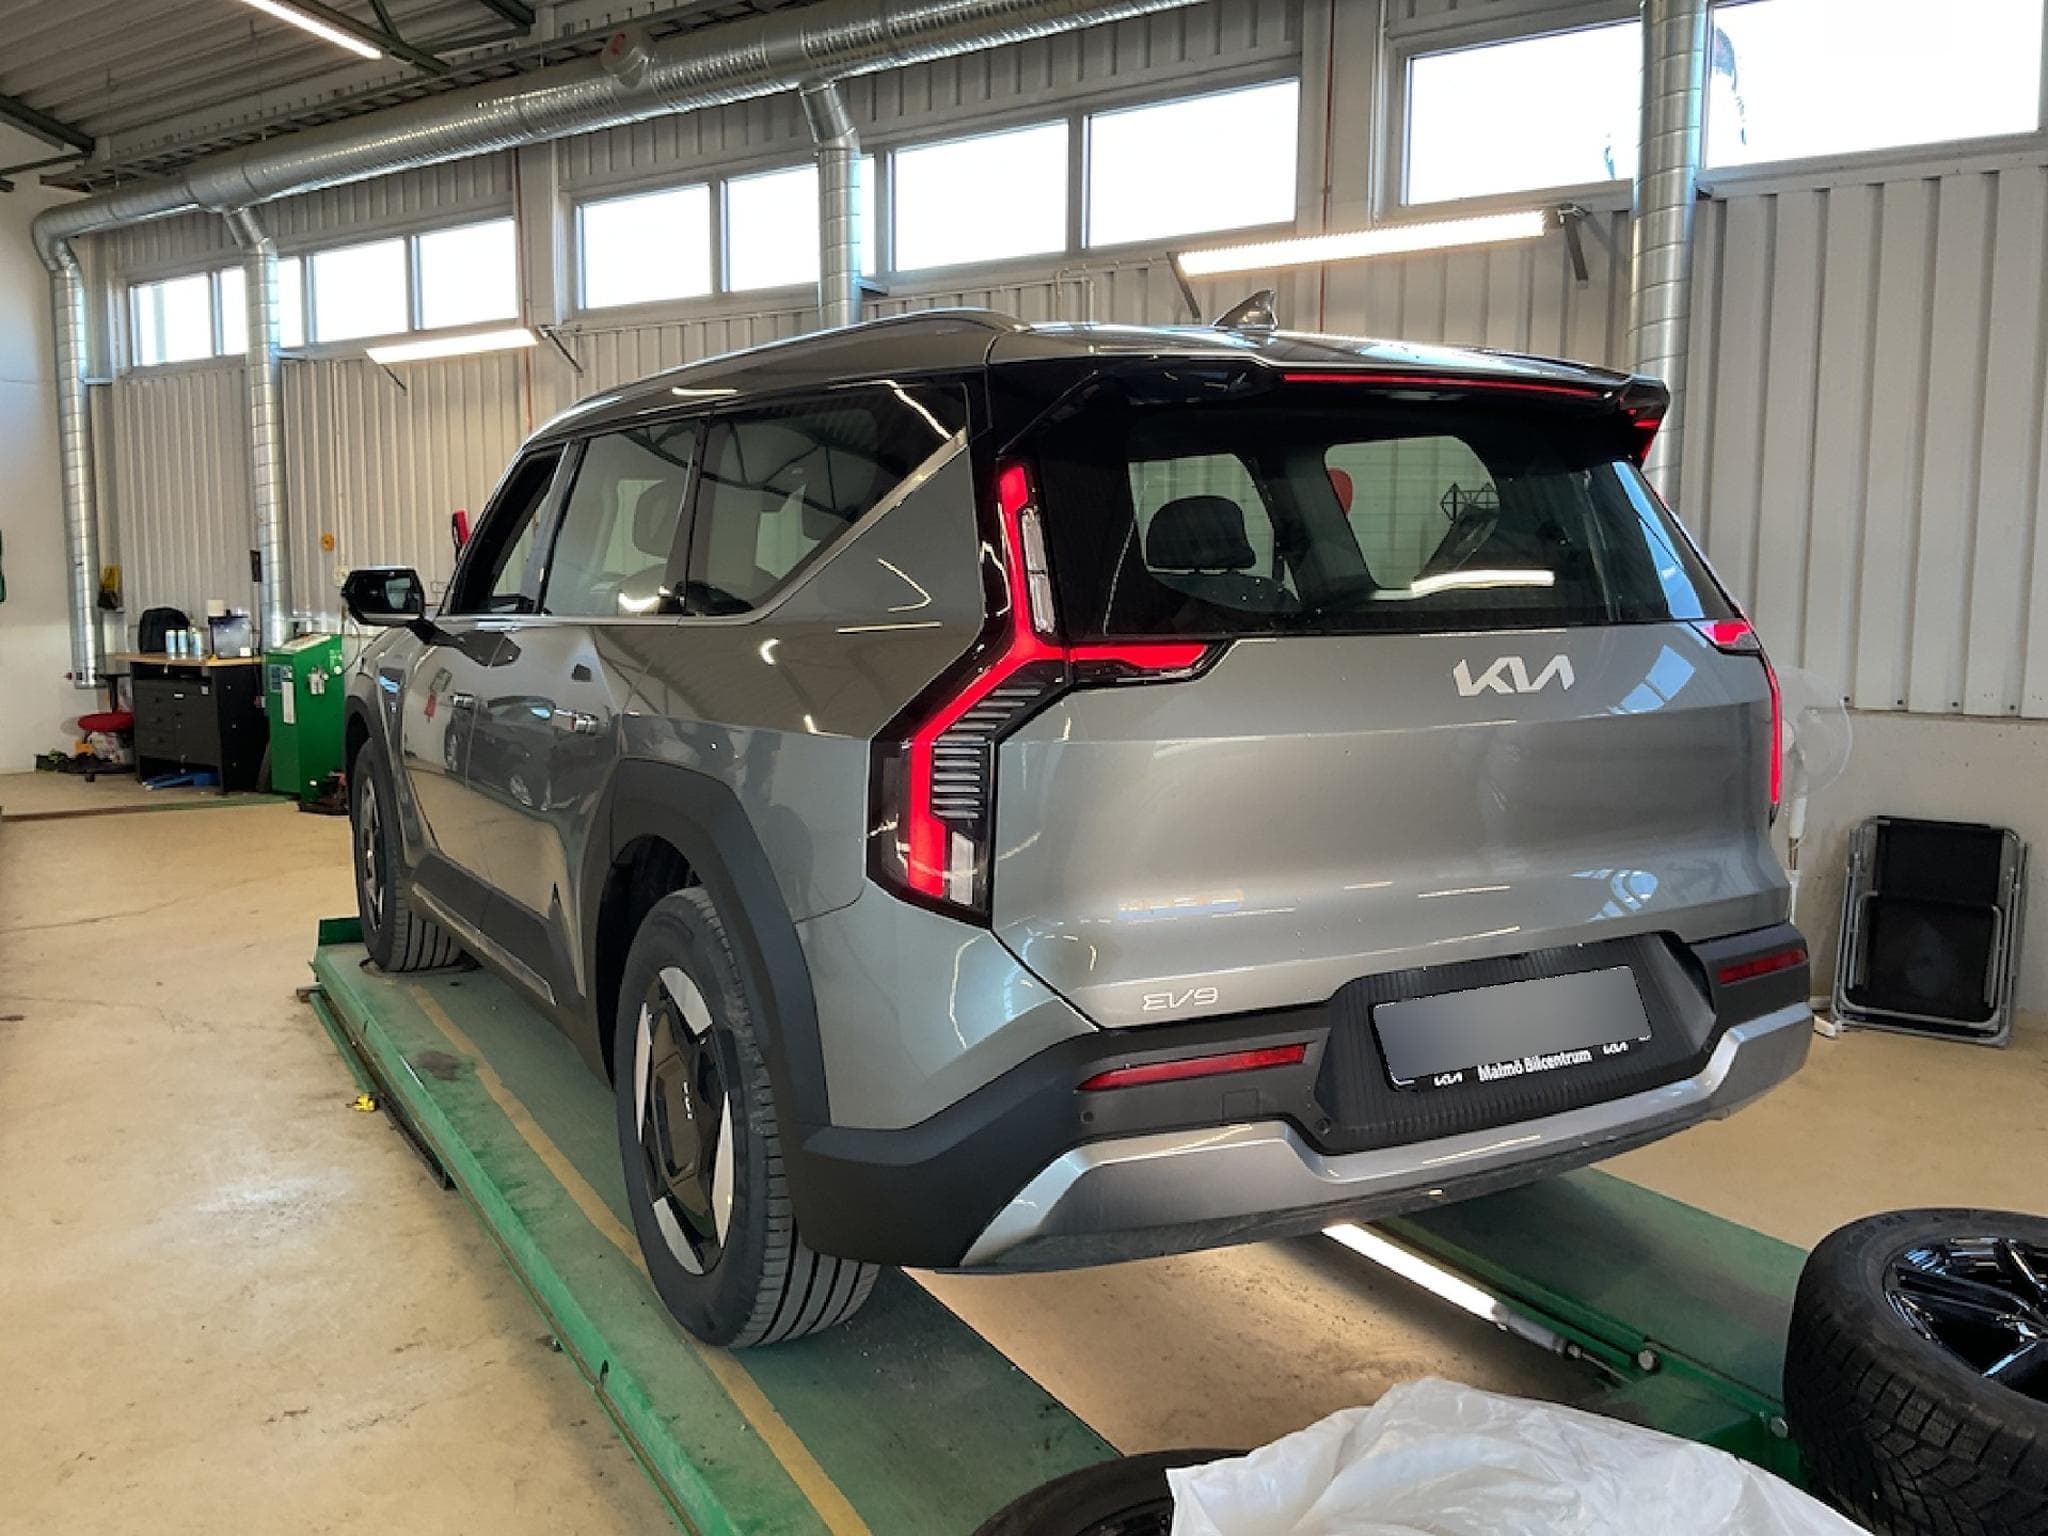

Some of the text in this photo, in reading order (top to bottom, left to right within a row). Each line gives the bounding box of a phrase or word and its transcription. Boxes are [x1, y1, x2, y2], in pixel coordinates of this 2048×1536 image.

[1453, 655, 1574, 696] KIA
[1143, 987, 1218, 1010] EV9
[1478, 1059, 1522, 1081] Malmö
[1524, 1050, 1592, 1073] Bilcentrum
